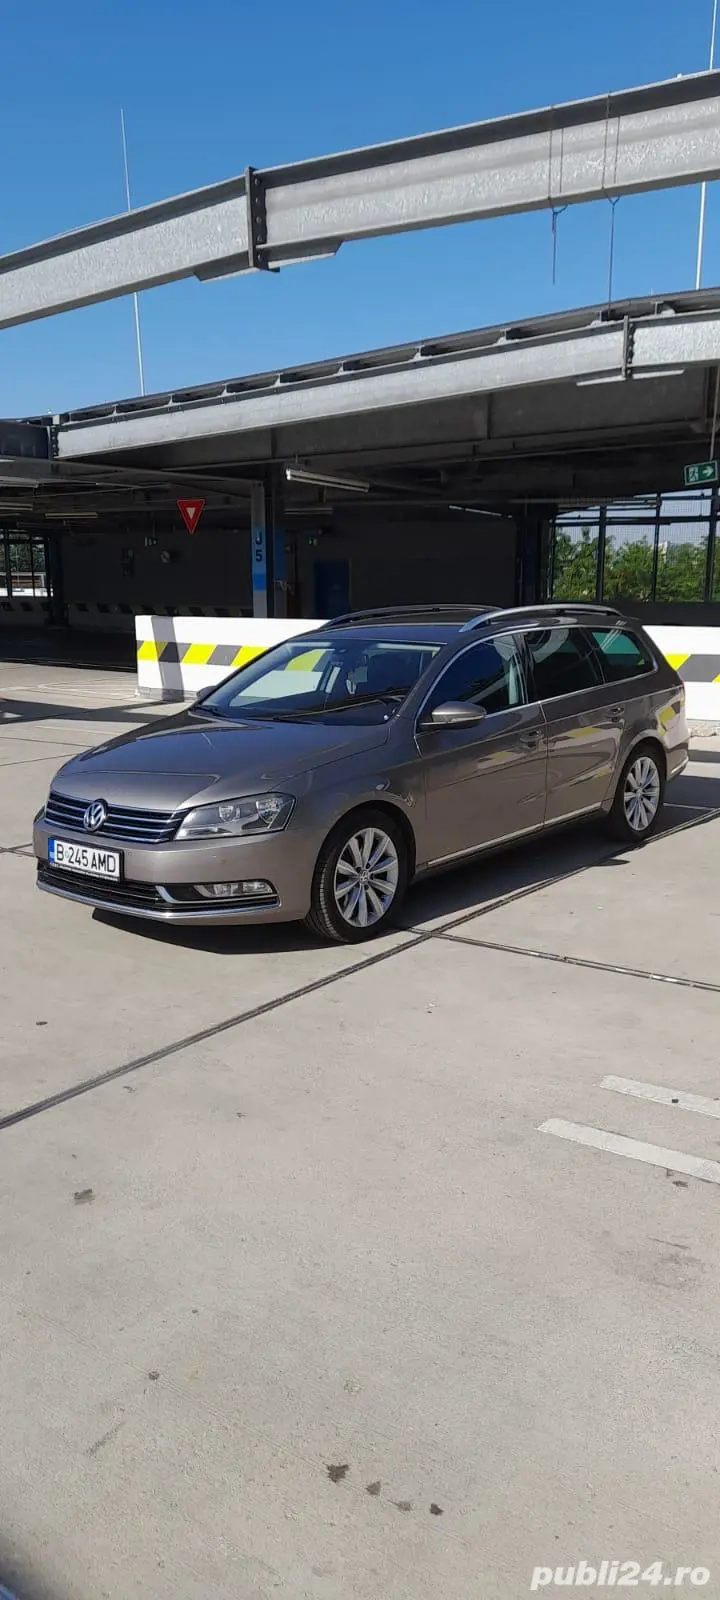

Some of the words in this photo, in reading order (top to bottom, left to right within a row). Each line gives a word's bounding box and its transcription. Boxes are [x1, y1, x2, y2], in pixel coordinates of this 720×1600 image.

[255, 532, 262, 545] J
[255, 549, 263, 562] 5
[56, 843, 64, 862] B
[68, 847, 88, 867] 245
[91, 851, 116, 873] AMD
